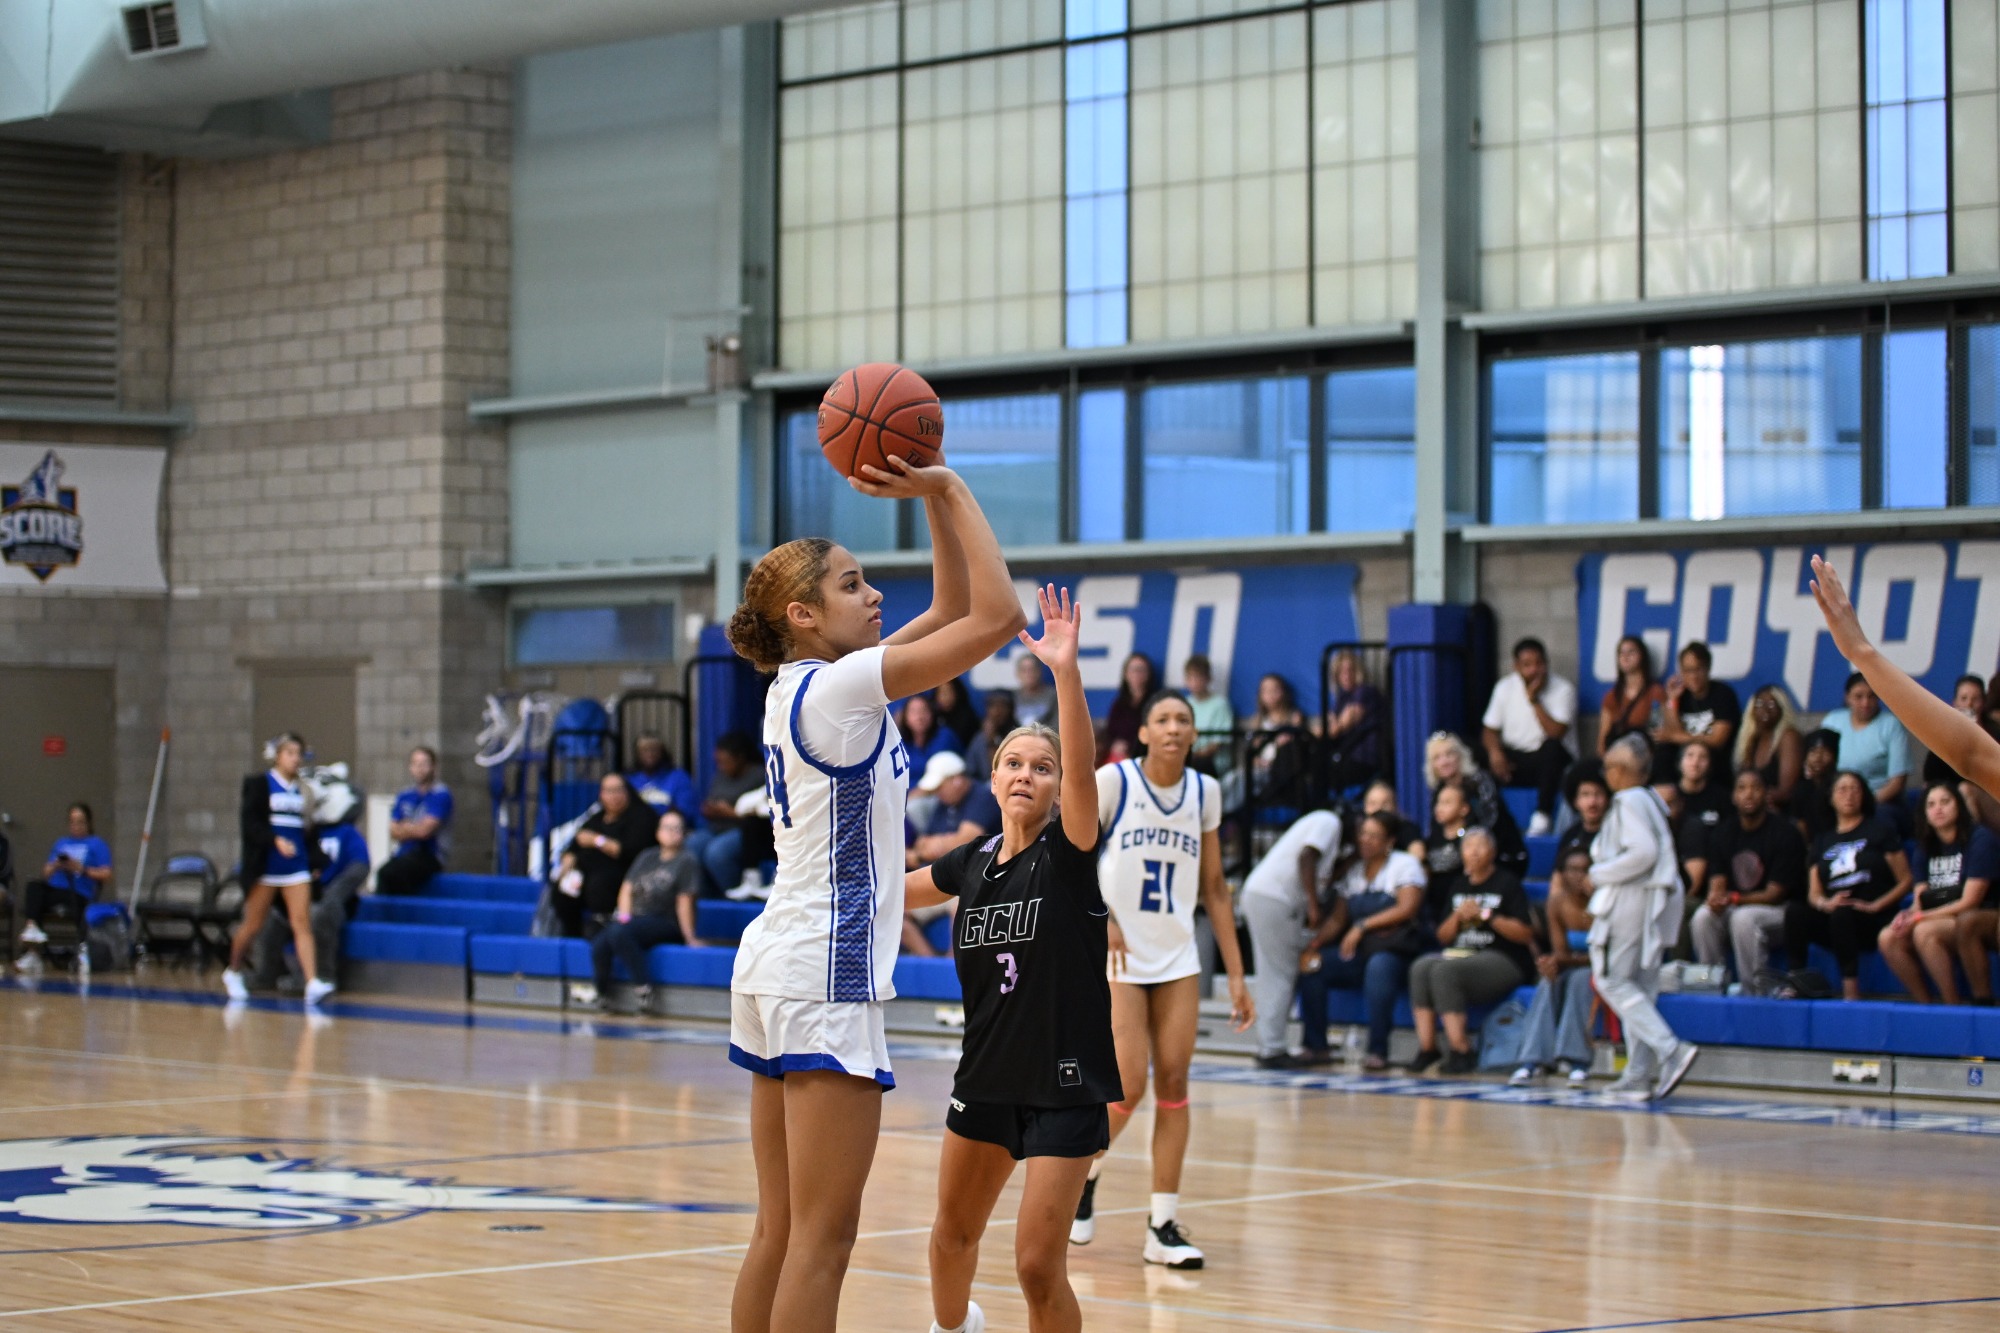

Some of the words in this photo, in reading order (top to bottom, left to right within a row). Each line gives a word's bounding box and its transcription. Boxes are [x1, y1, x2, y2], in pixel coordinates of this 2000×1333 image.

[0, 508, 83, 549] SCORE
[1121, 828, 1198, 858] COYOTES
[1139, 859, 1176, 914] 21
[959, 897, 1043, 949] GCU
[996, 952, 1019, 995] 3
